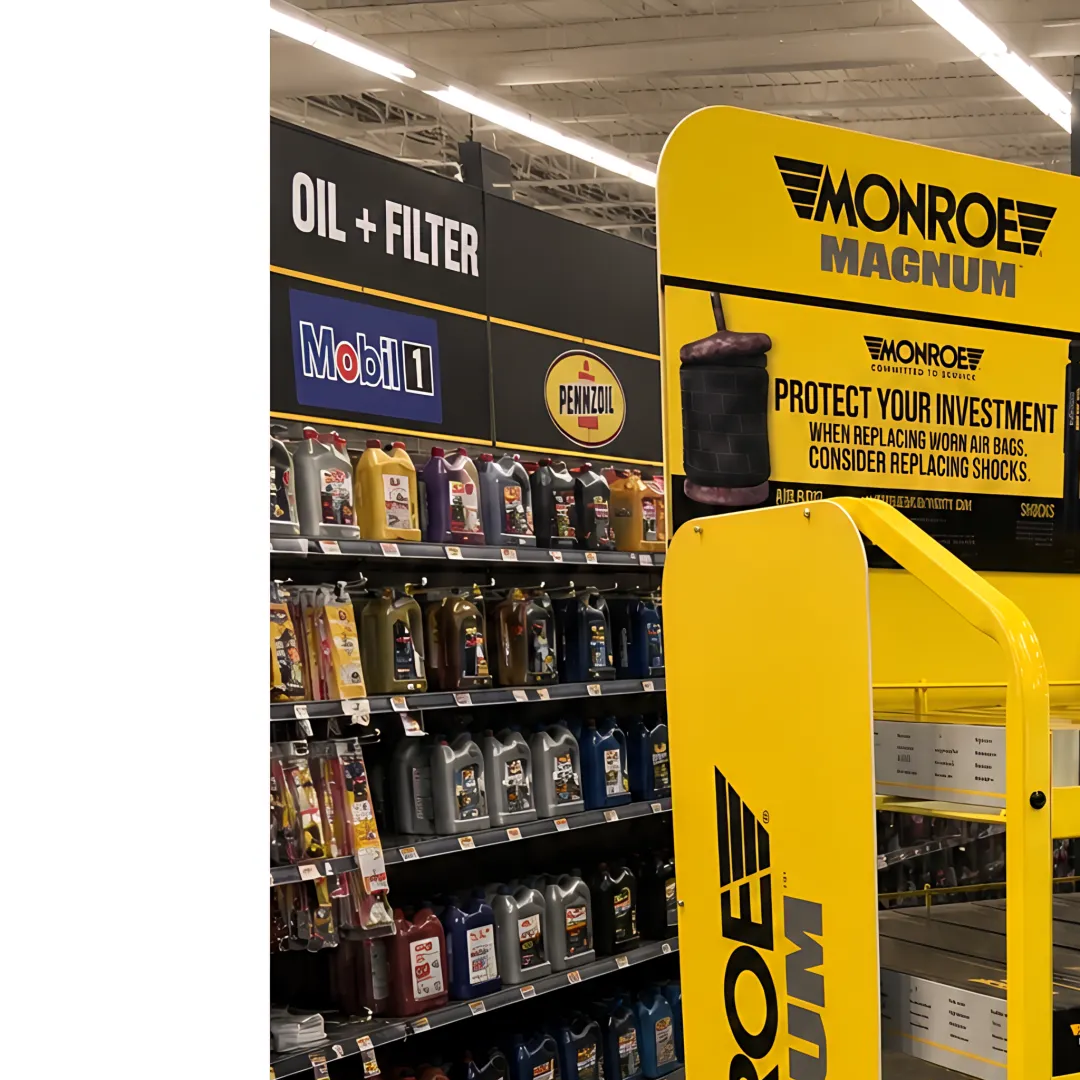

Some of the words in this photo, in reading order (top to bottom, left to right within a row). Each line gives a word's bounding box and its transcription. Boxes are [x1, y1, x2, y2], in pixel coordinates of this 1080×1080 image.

[292, 171, 346, 242] OIL
[355, 208, 377, 244] +
[385, 199, 479, 277] FILTER
[814, 163, 1022, 255] MONROE
[820, 233, 1016, 299] MAGNUM
[299, 320, 400, 391] Mobil
[879, 337, 970, 370] MONROE
[559, 384, 614, 415] PENNZOIL
[774, 377, 873, 419] PROTECT
[876, 387, 931, 424] YOUR
[936, 393, 1058, 434] INVESTMENT
[808, 421, 850, 445] WHEN
[853, 426, 926, 451] REPLACING
[929, 431, 967, 453] WORN
[970, 435, 989, 455] AIR
[993, 437, 1028, 458] BAGS.
[808, 445, 886, 473] CONSIDER
[890, 453, 969, 479] REPLACING
[972, 458, 1031, 483] SHOCKS.
